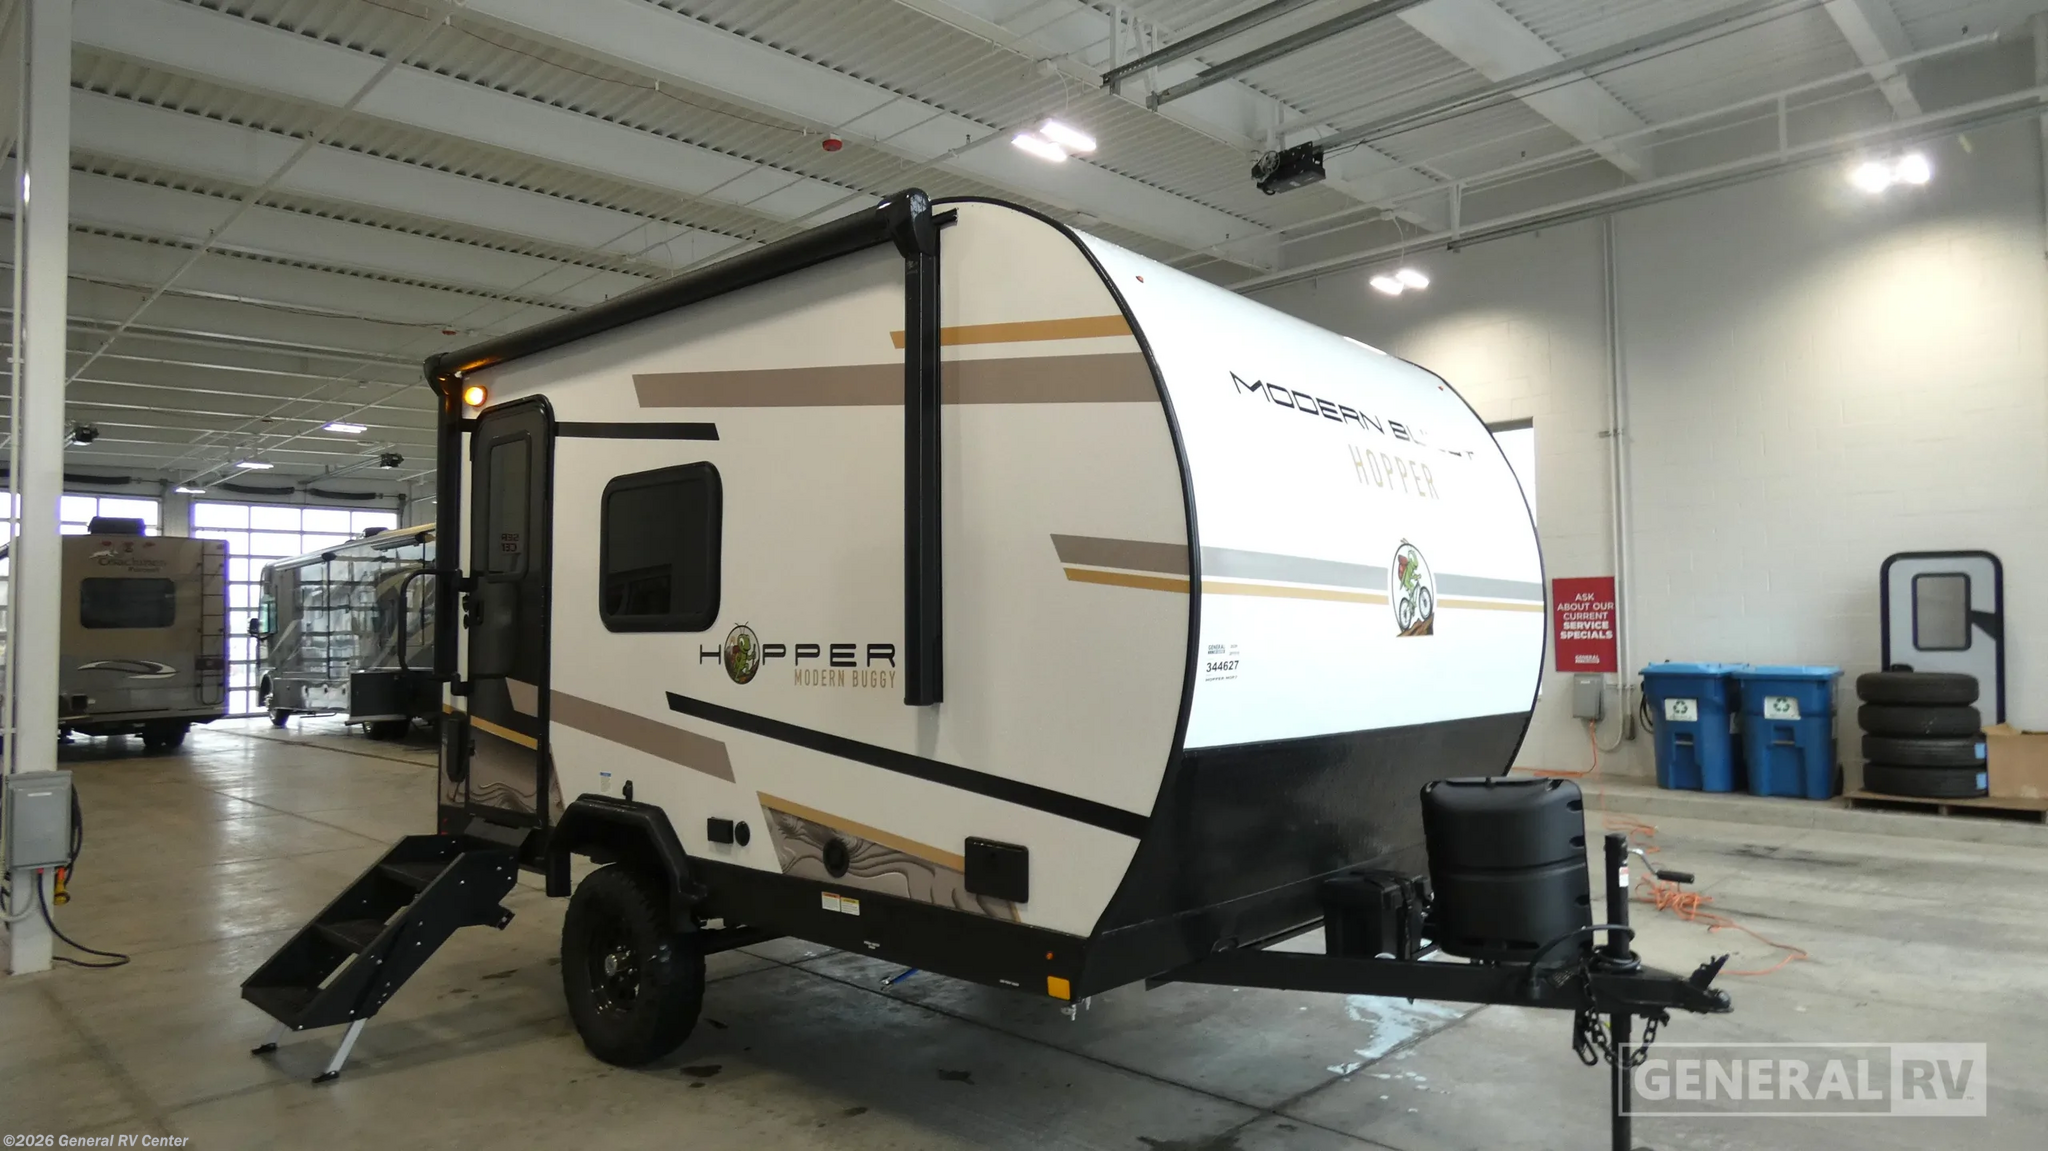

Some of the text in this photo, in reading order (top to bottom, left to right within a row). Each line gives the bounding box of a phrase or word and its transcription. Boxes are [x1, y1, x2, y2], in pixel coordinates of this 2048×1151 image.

[1229, 370, 1385, 434] MODERN
[1347, 444, 1440, 500] HOPPER
[1575, 593, 1595, 601] ASK
[1557, 602, 1614, 611] ABOUT OUR
[1563, 612, 1608, 620] CURRENT
[1563, 621, 1609, 630] SERVICE
[1560, 631, 1613, 639] SPECIALS
[1206, 660, 1239, 672] 344627
[794, 669, 896, 689] MODERN BUGGY
